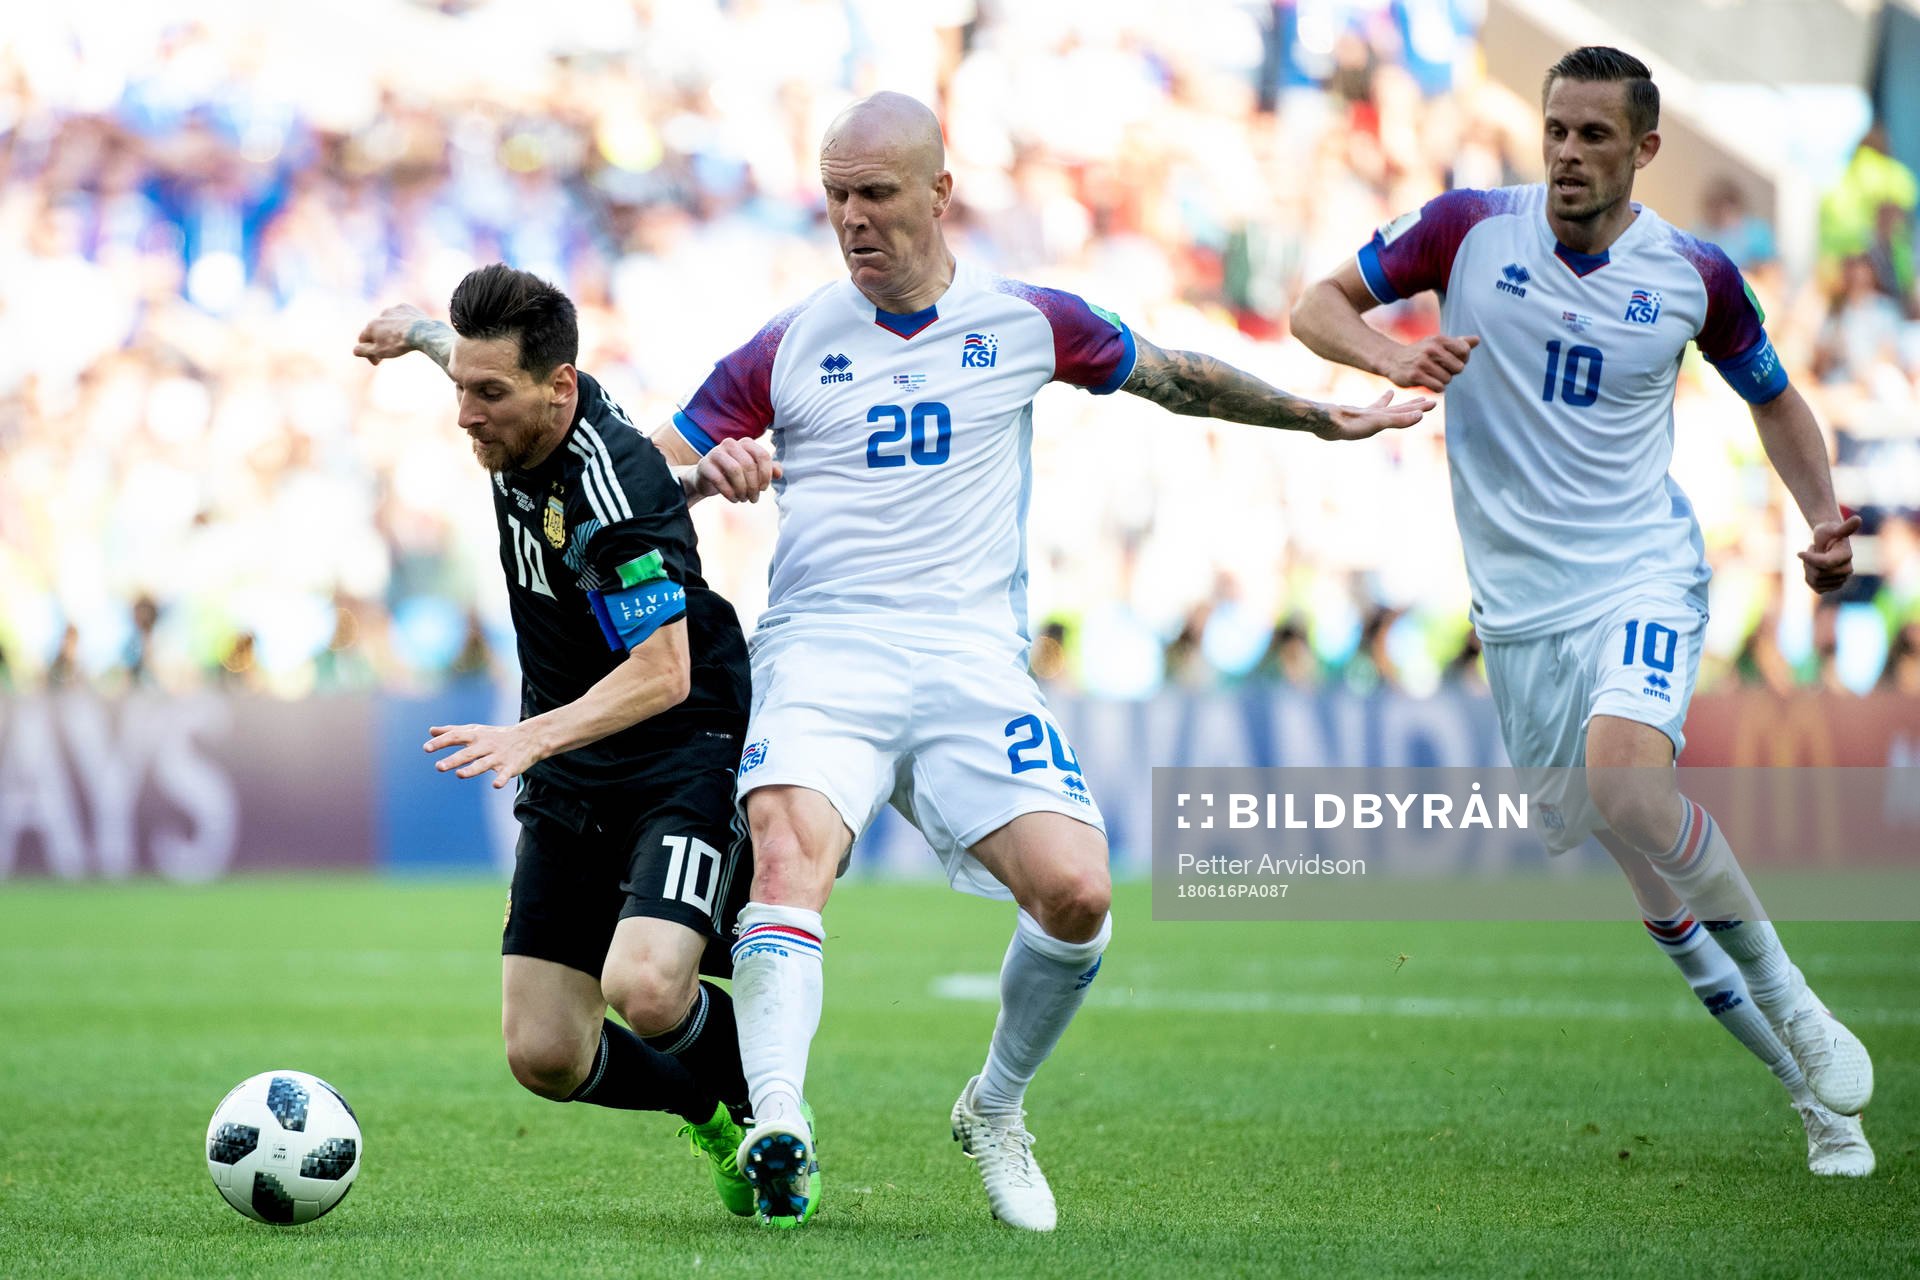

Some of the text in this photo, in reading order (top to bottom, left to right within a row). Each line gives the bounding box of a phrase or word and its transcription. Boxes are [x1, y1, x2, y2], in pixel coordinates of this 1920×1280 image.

[820, 371, 854, 385] errea
[1541, 340, 1604, 407] 10
[866, 402, 952, 468] 20
[507, 513, 558, 601] 10
[1623, 619, 1678, 673] 10
[1643, 687, 1671, 703] errea
[1005, 714, 1082, 776] 20
[661, 835, 723, 917] 10
